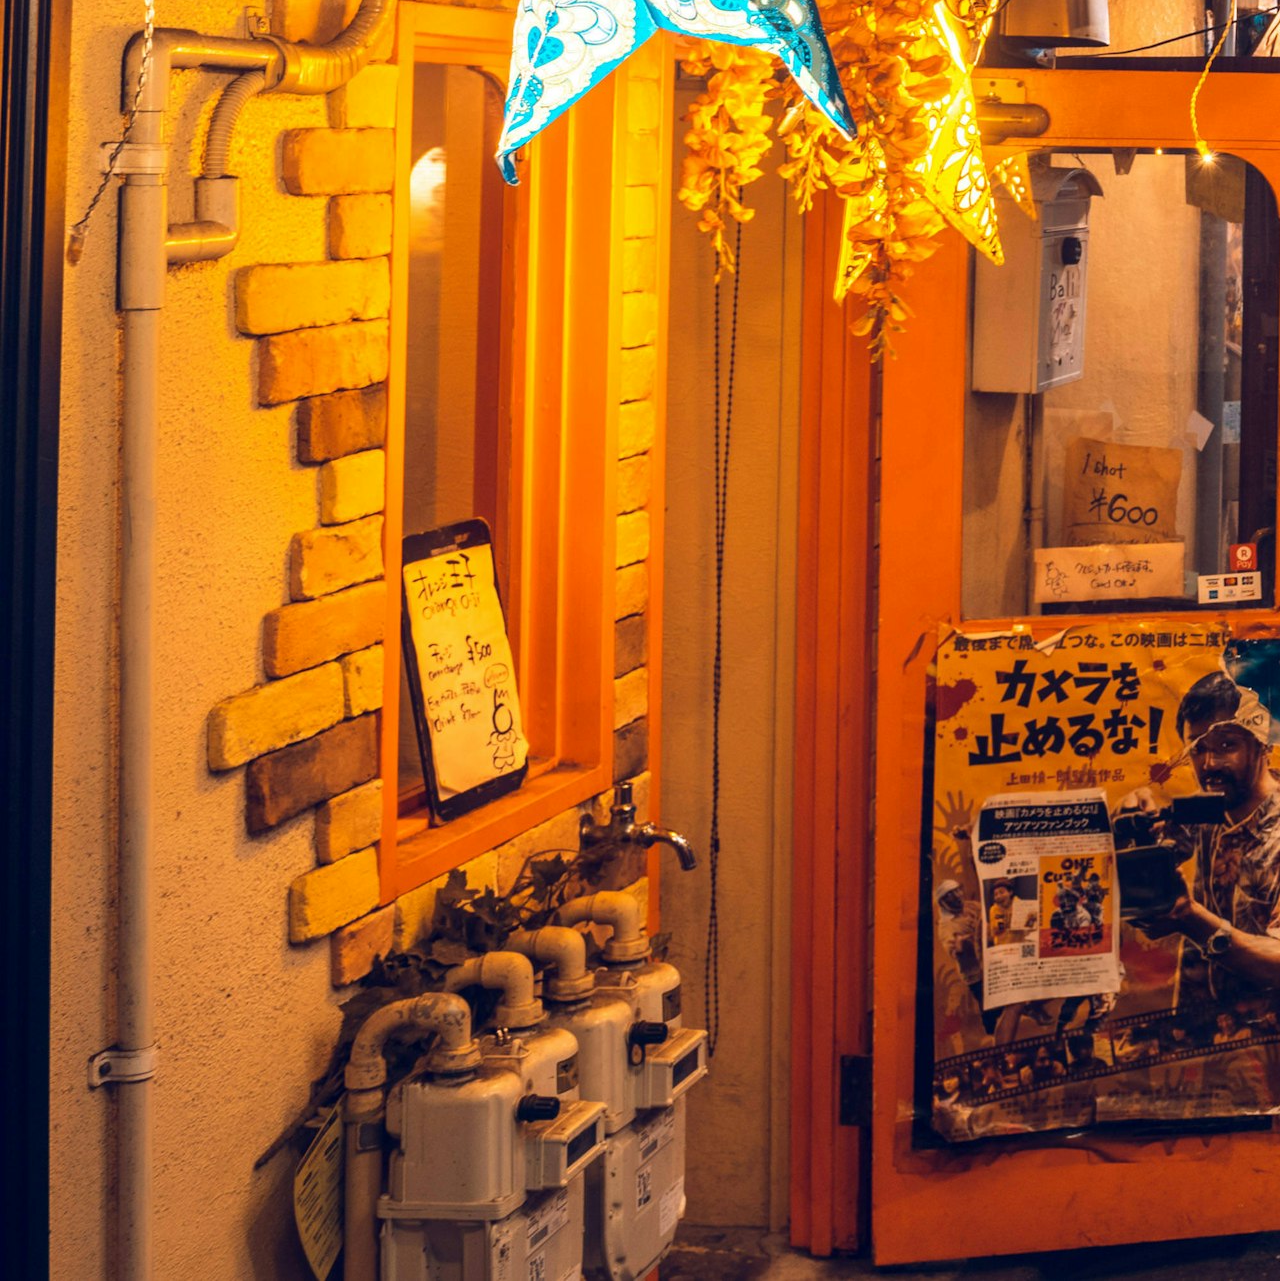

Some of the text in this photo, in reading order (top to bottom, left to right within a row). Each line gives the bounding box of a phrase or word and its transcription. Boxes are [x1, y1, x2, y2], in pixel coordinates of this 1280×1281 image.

[1050, 269, 1075, 301] Bali
[1093, 456, 1127, 479] shot
[1089, 488, 1158, 526] ¥600
[1236, 560, 1253, 569] Pay
[995, 659, 1142, 709] カメラを
[1060, 856, 1095, 870] ONE
